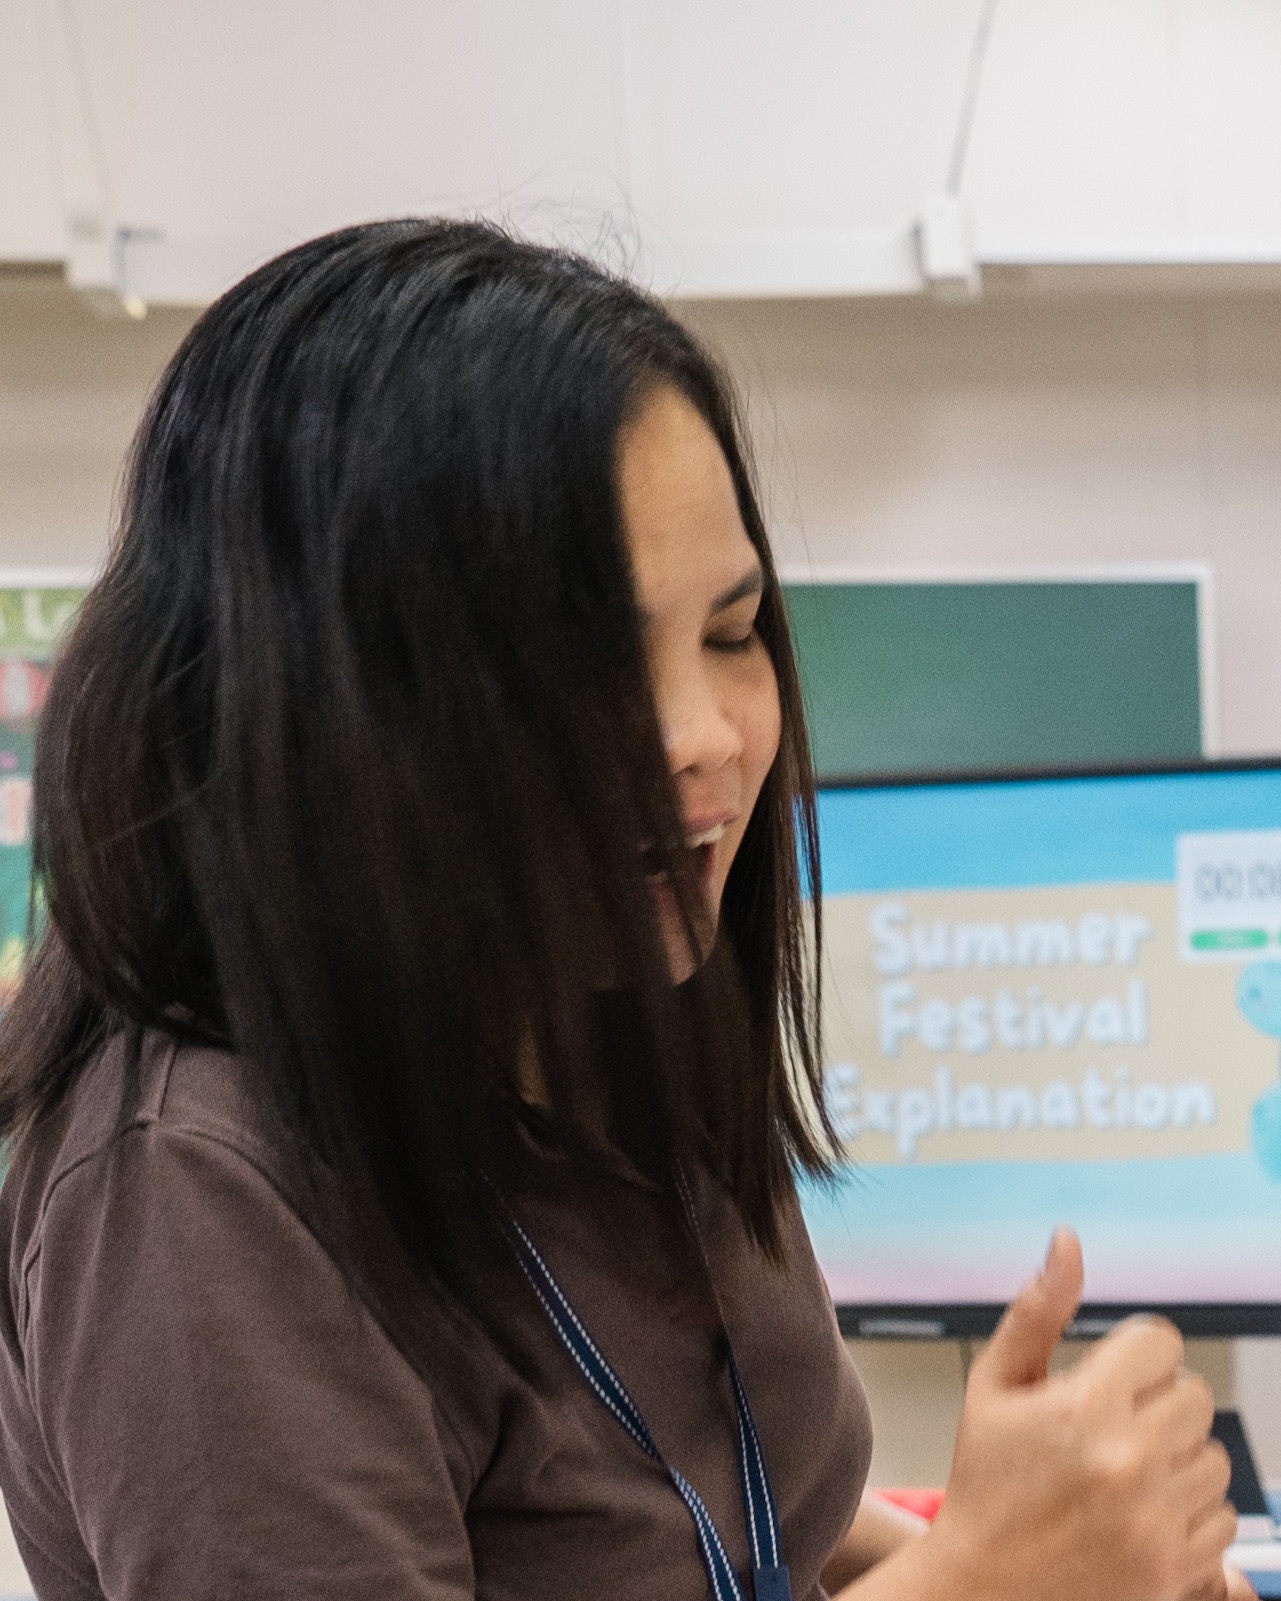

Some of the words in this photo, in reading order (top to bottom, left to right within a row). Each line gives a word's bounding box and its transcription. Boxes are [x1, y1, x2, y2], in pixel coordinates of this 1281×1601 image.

[868, 902, 1154, 977] Summer
[877, 977, 1148, 1058] Festival
[824, 1061, 1217, 1161] Explanation
